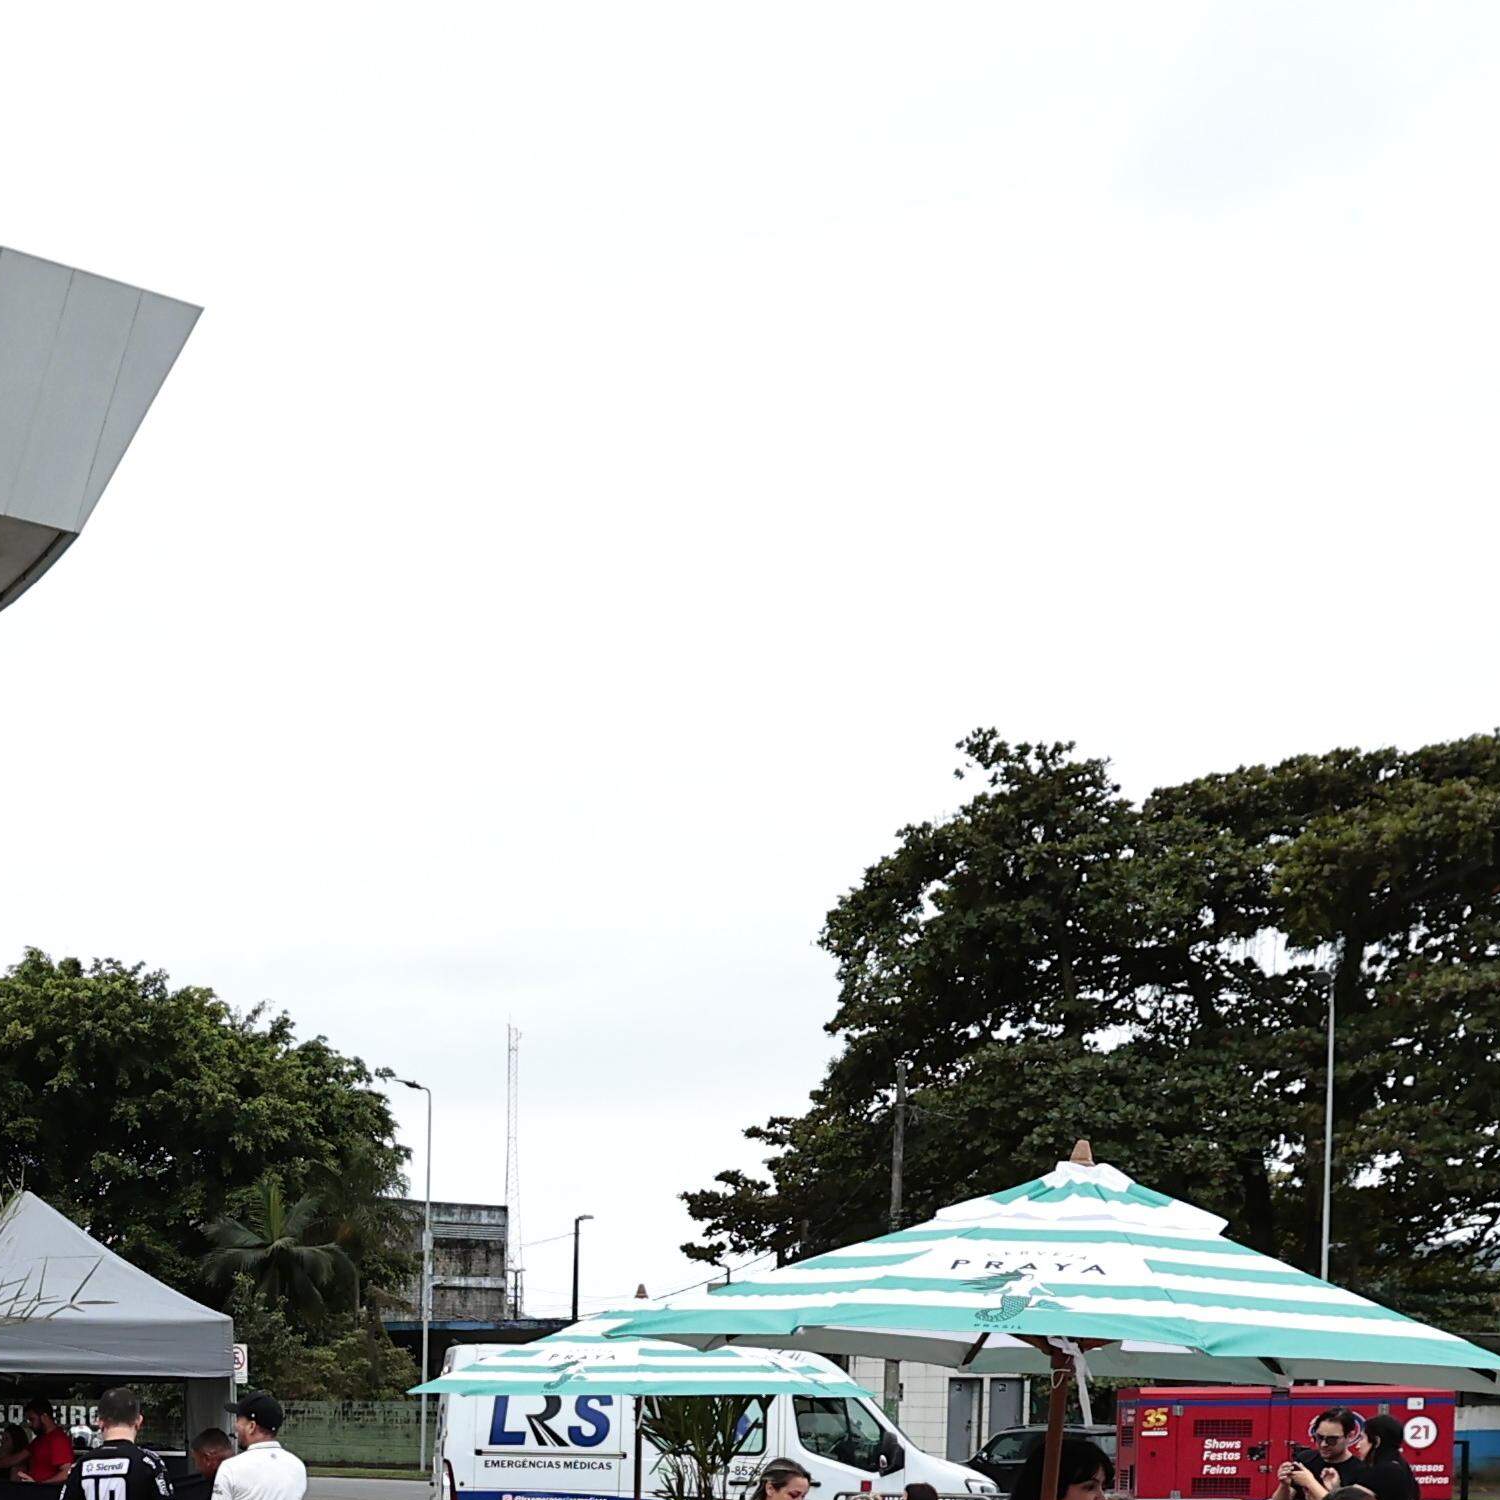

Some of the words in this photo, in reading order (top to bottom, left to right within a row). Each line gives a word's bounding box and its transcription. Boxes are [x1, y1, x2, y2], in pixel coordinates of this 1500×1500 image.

[951, 1259, 1106, 1275] PRAYA
[489, 1395, 614, 1447] LRS
[1142, 1407, 1169, 1428] 35
[1410, 1425, 1430, 1440] 21
[1204, 1439, 1241, 1449] Shows
[1203, 1451, 1240, 1461] Festas
[96, 1462, 123, 1471] Sicredi
[484, 1459, 561, 1469] EMERGÊNCIAS
[563, 1461, 612, 1470] MÉDICAS
[1202, 1464, 1237, 1475] Feiras
